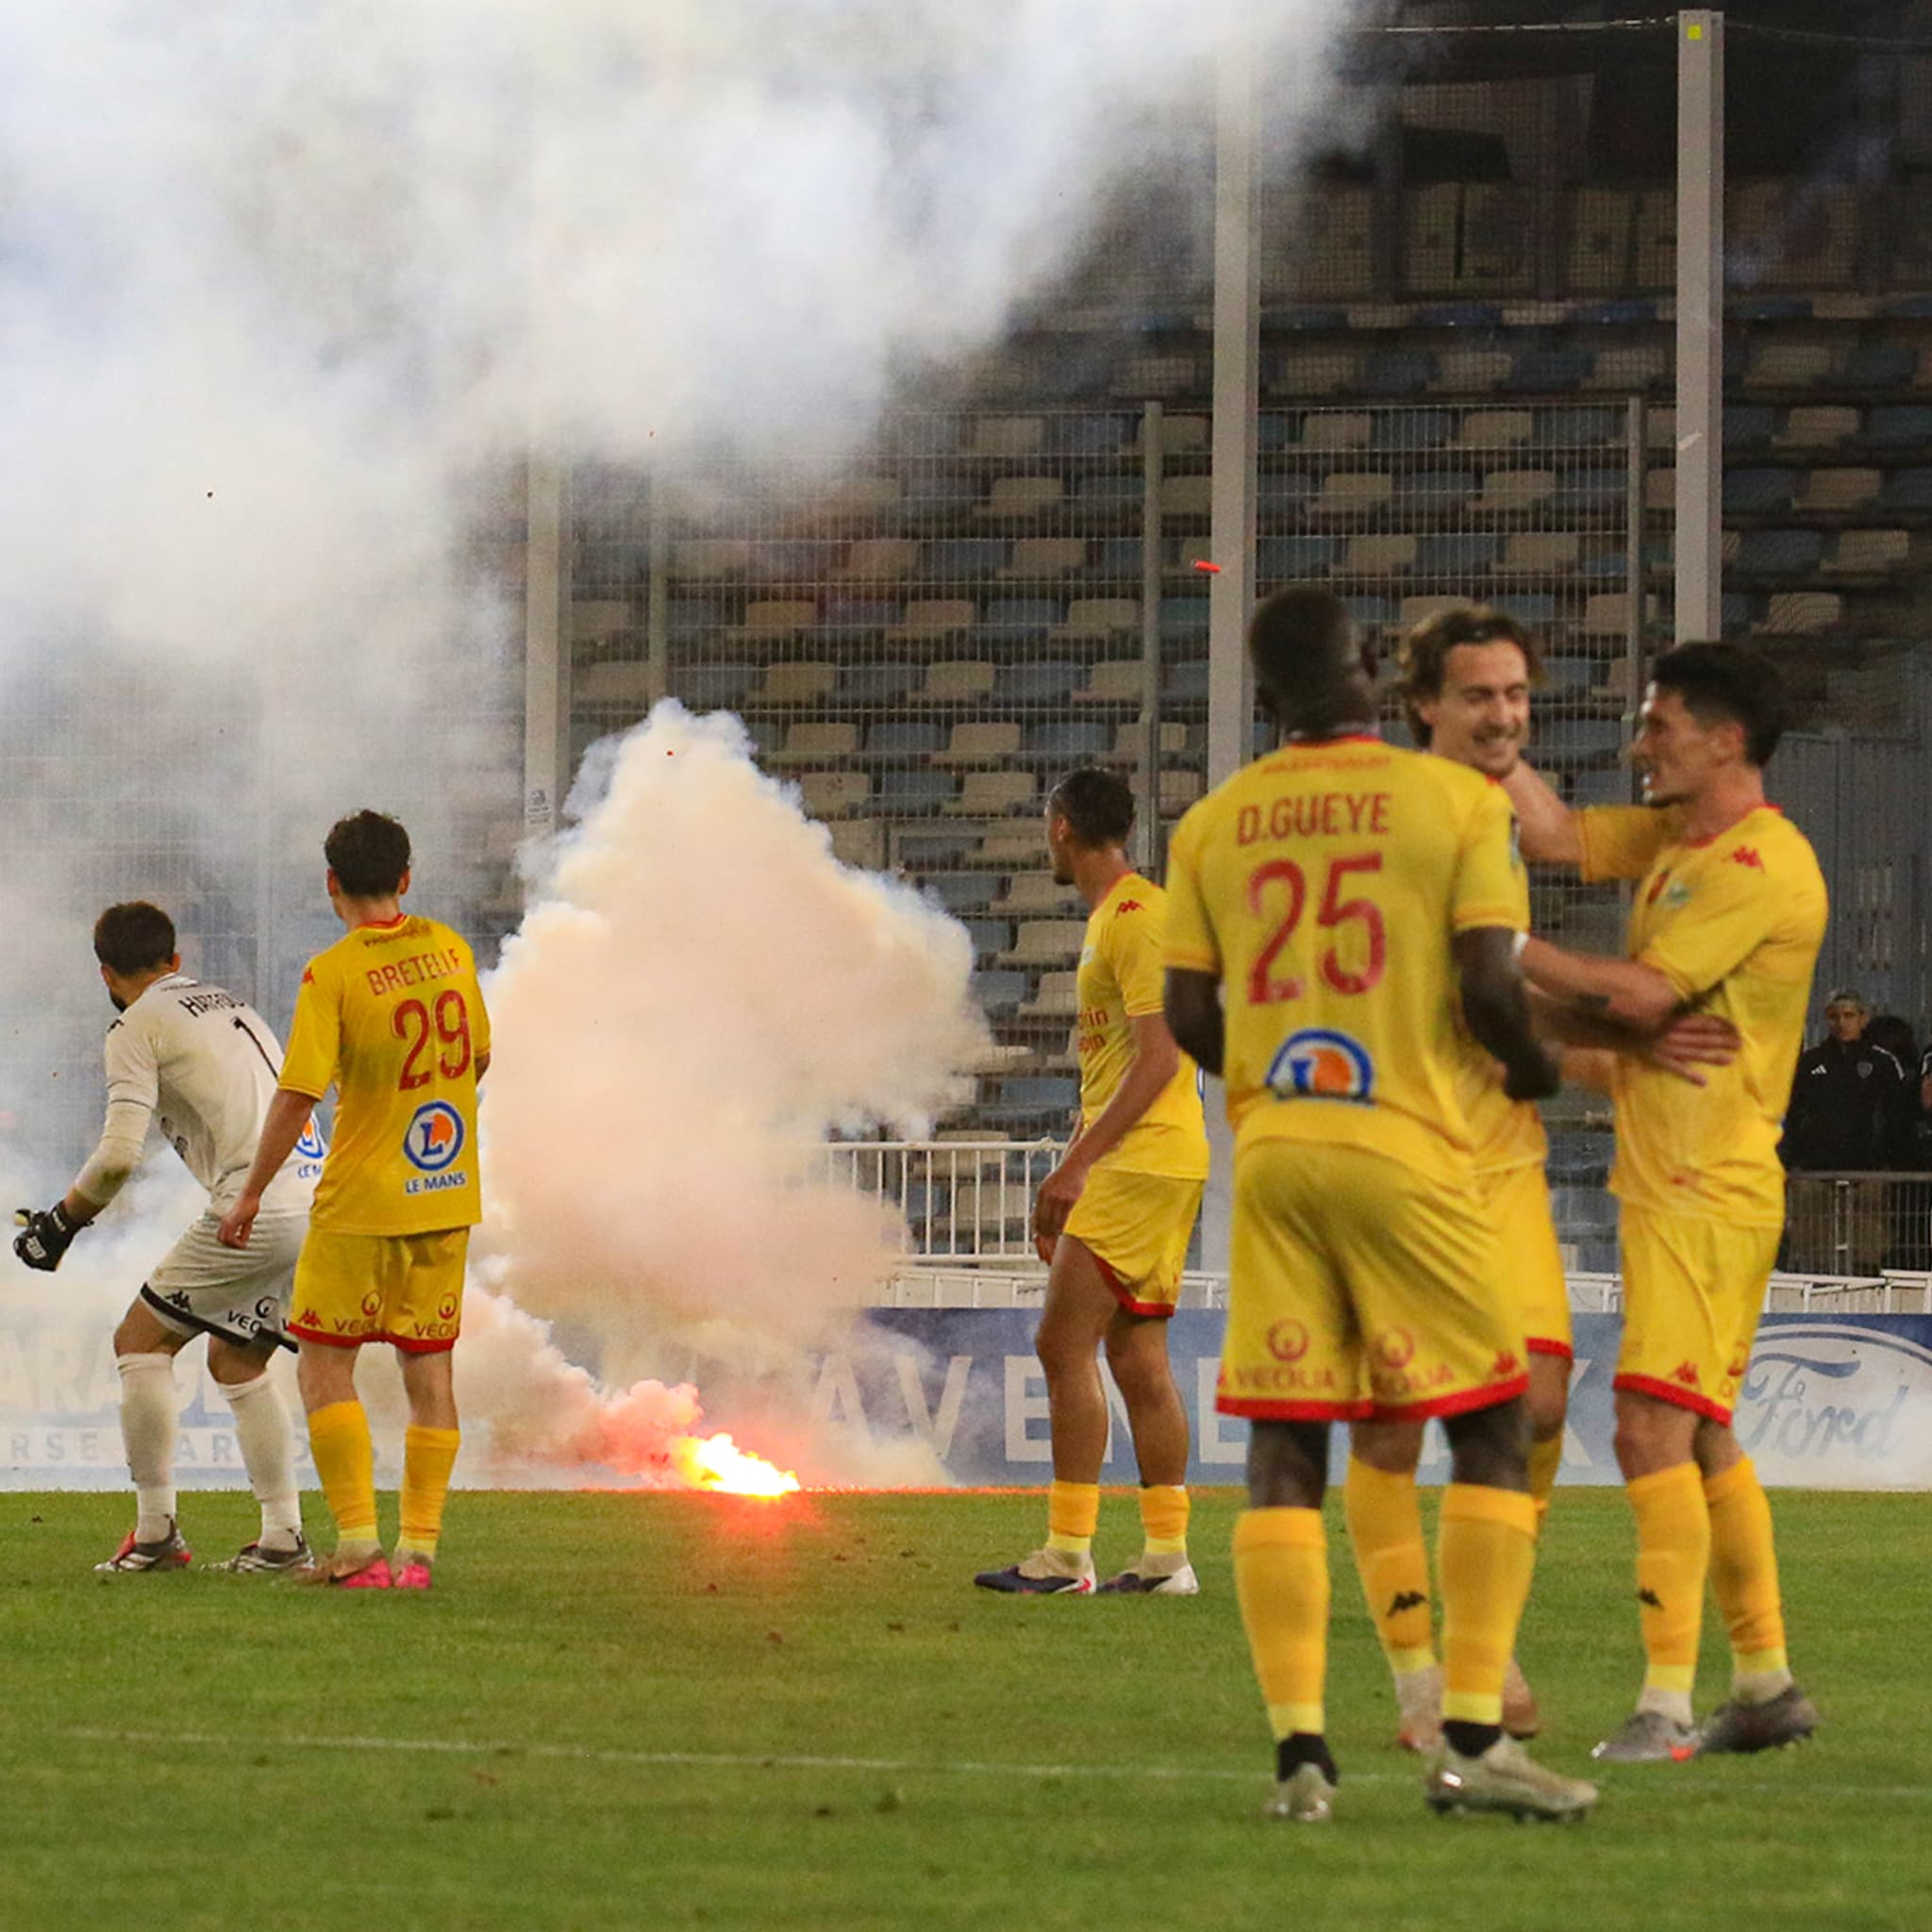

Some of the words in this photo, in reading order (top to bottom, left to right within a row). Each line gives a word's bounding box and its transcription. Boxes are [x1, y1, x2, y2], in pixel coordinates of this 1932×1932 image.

[1237, 791, 1391, 847] D.GUEYE
[1247, 851, 1387, 1006] 25
[365, 947, 464, 996] BRETELLE
[231, 1016, 280, 1085] 1
[392, 989, 472, 1091] 29
[405, 1178, 421, 1194] LE
[425, 1172, 466, 1191] MANS
[227, 1309, 263, 1333] VEO
[1741, 1353, 1910, 1458] Ford
